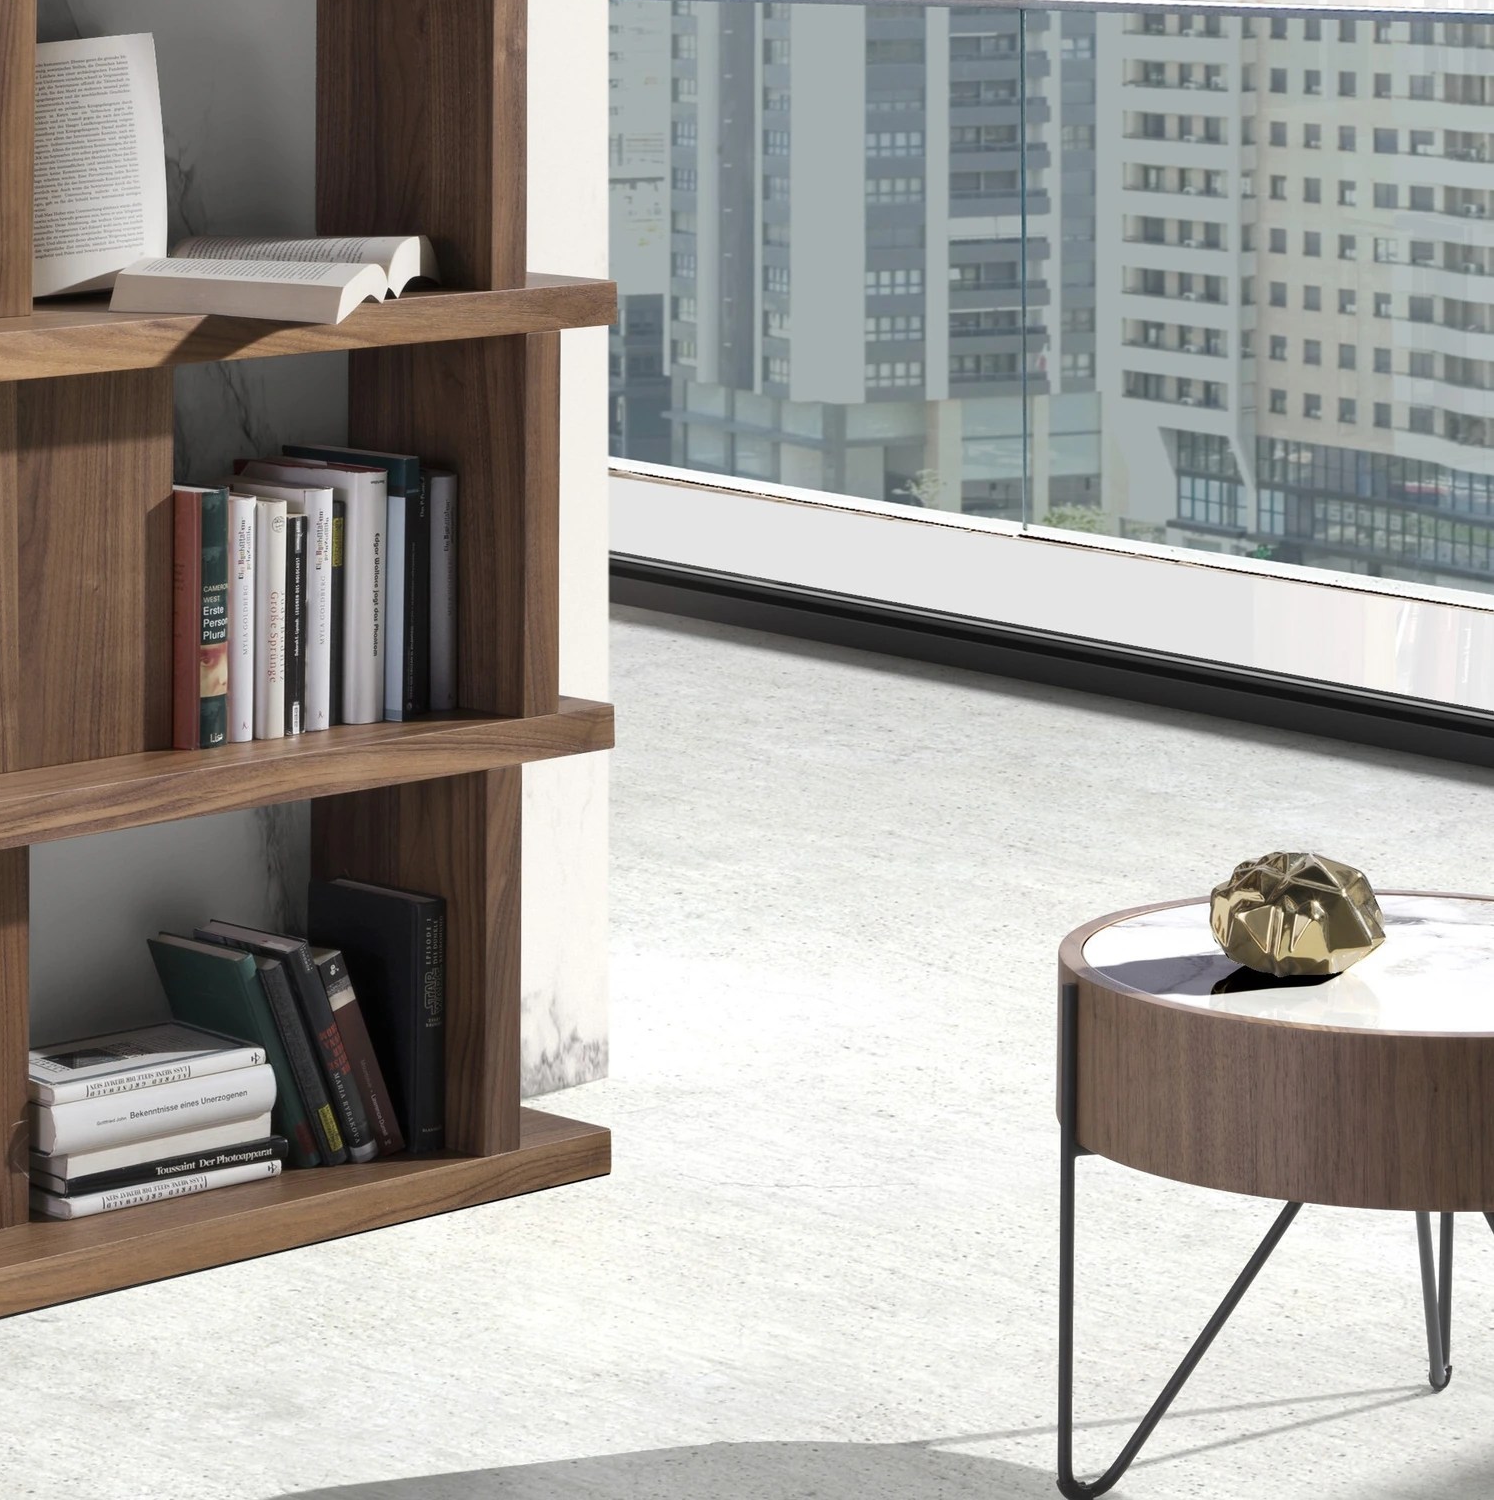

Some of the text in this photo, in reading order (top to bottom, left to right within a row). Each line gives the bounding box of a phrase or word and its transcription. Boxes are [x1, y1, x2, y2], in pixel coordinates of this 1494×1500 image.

[203, 595, 220, 603] WEST
[203, 606, 224, 616] Erste
[203, 629, 226, 640] Plural
[268, 632, 278, 683] Sprünge
[424, 968, 437, 1012] STAR
[152, 1074, 188, 1085] ALFRED
[96, 1118, 116, 1126] Gottfried
[130, 1104, 178, 1120] Bekenntnisse
[180, 1100, 200, 1110] eines
[200, 1090, 248, 1106] Unerzogenen
[332, 1072, 360, 1144] MARIA RYBAKOVA
[156, 1148, 272, 1176] Toussaint Der Photoapparat
[168, 1184, 204, 1196] ALFRED
